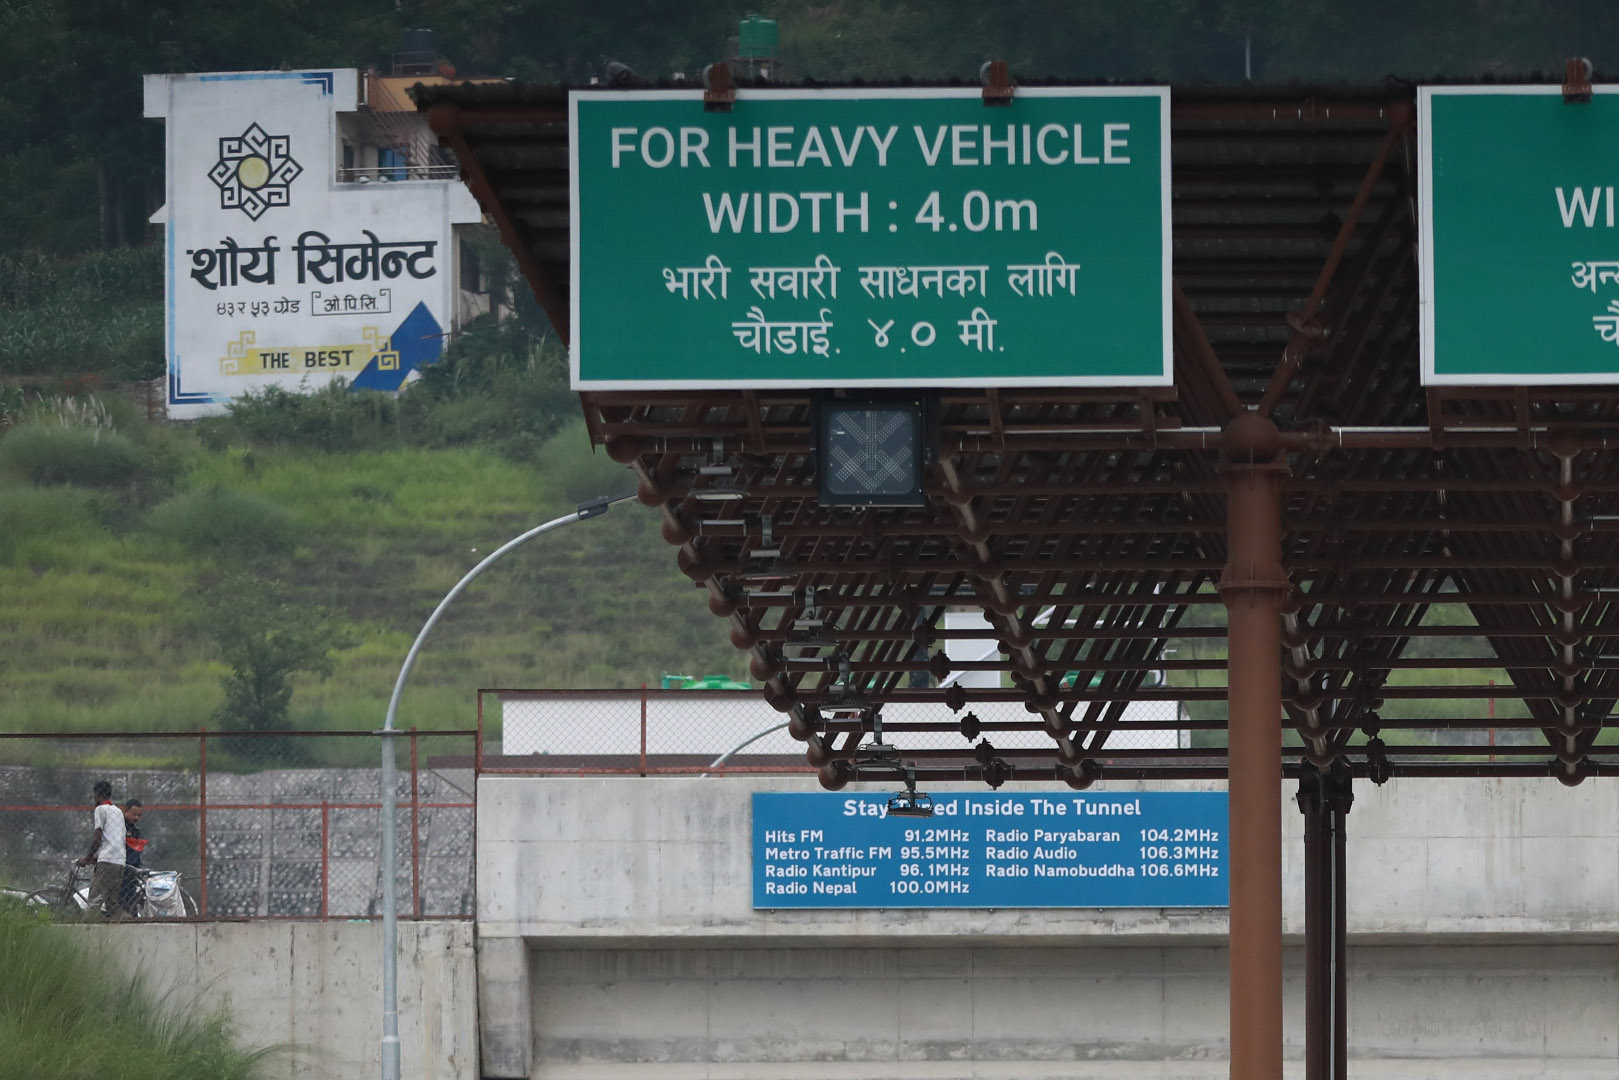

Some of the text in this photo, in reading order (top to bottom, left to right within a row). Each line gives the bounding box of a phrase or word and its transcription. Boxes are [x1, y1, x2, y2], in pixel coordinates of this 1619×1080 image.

[611, 123, 1131, 169] FOR HEAVY VEHICLE
[702, 191, 869, 234] WIDTH
[914, 190, 1038, 232] 4.0m
[186, 229, 438, 291] शौर्य सिमेन्ट
[662, 251, 1081, 300] भारी सवारी साधनका लागि
[259, 349, 354, 369] THE BEST
[843, 798, 1142, 819] Stay Ted Inside The Tunnel
[765, 829, 970, 843] Hits FM 91.2MHz
[986, 828, 1219, 845] Radio Paryabaran 104.2MHz
[765, 846, 970, 860] Metro Traffic FM 95.5MHz
[986, 846, 1219, 860] Radio Audio 106.3MHz
[765, 864, 808, 878] Radio
[812, 863, 877, 879] Kantipur
[986, 863, 1219, 877] Radio Namobuddha 106.6MHz
[765, 880, 970, 897] Radio Nepal 100.0MHz
